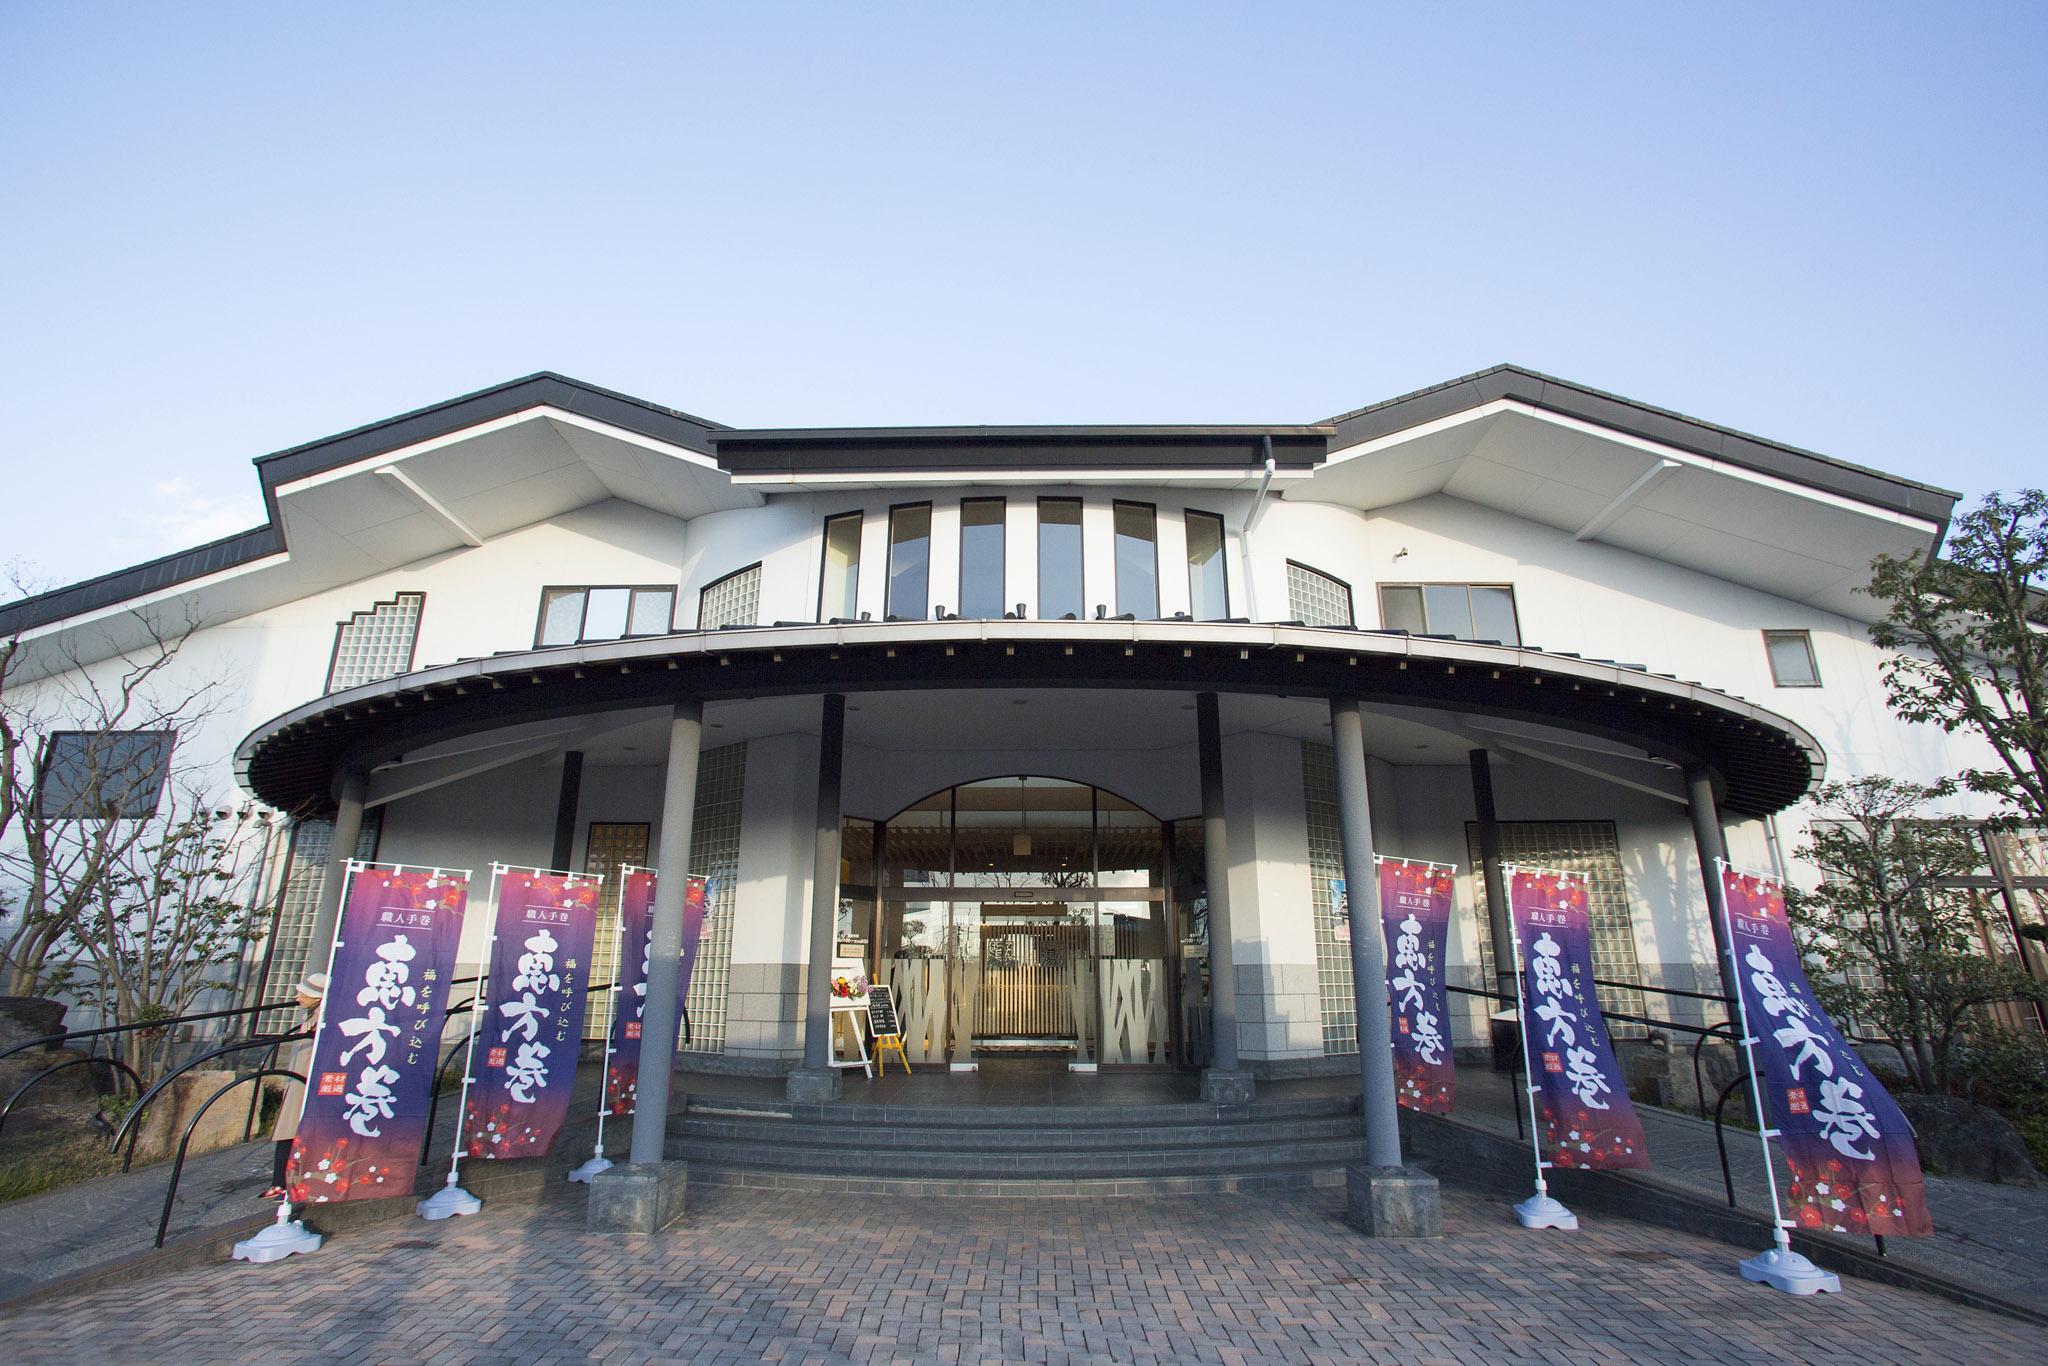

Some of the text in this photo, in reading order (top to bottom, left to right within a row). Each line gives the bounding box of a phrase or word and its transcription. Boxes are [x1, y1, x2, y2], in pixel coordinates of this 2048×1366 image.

[380, 911, 432, 926] 職人手巻
[525, 909, 569, 922] 職人手巻
[406, 968, 437, 1065] 福を呼び込む
[556, 958, 577, 1042] 福を呼び込む
